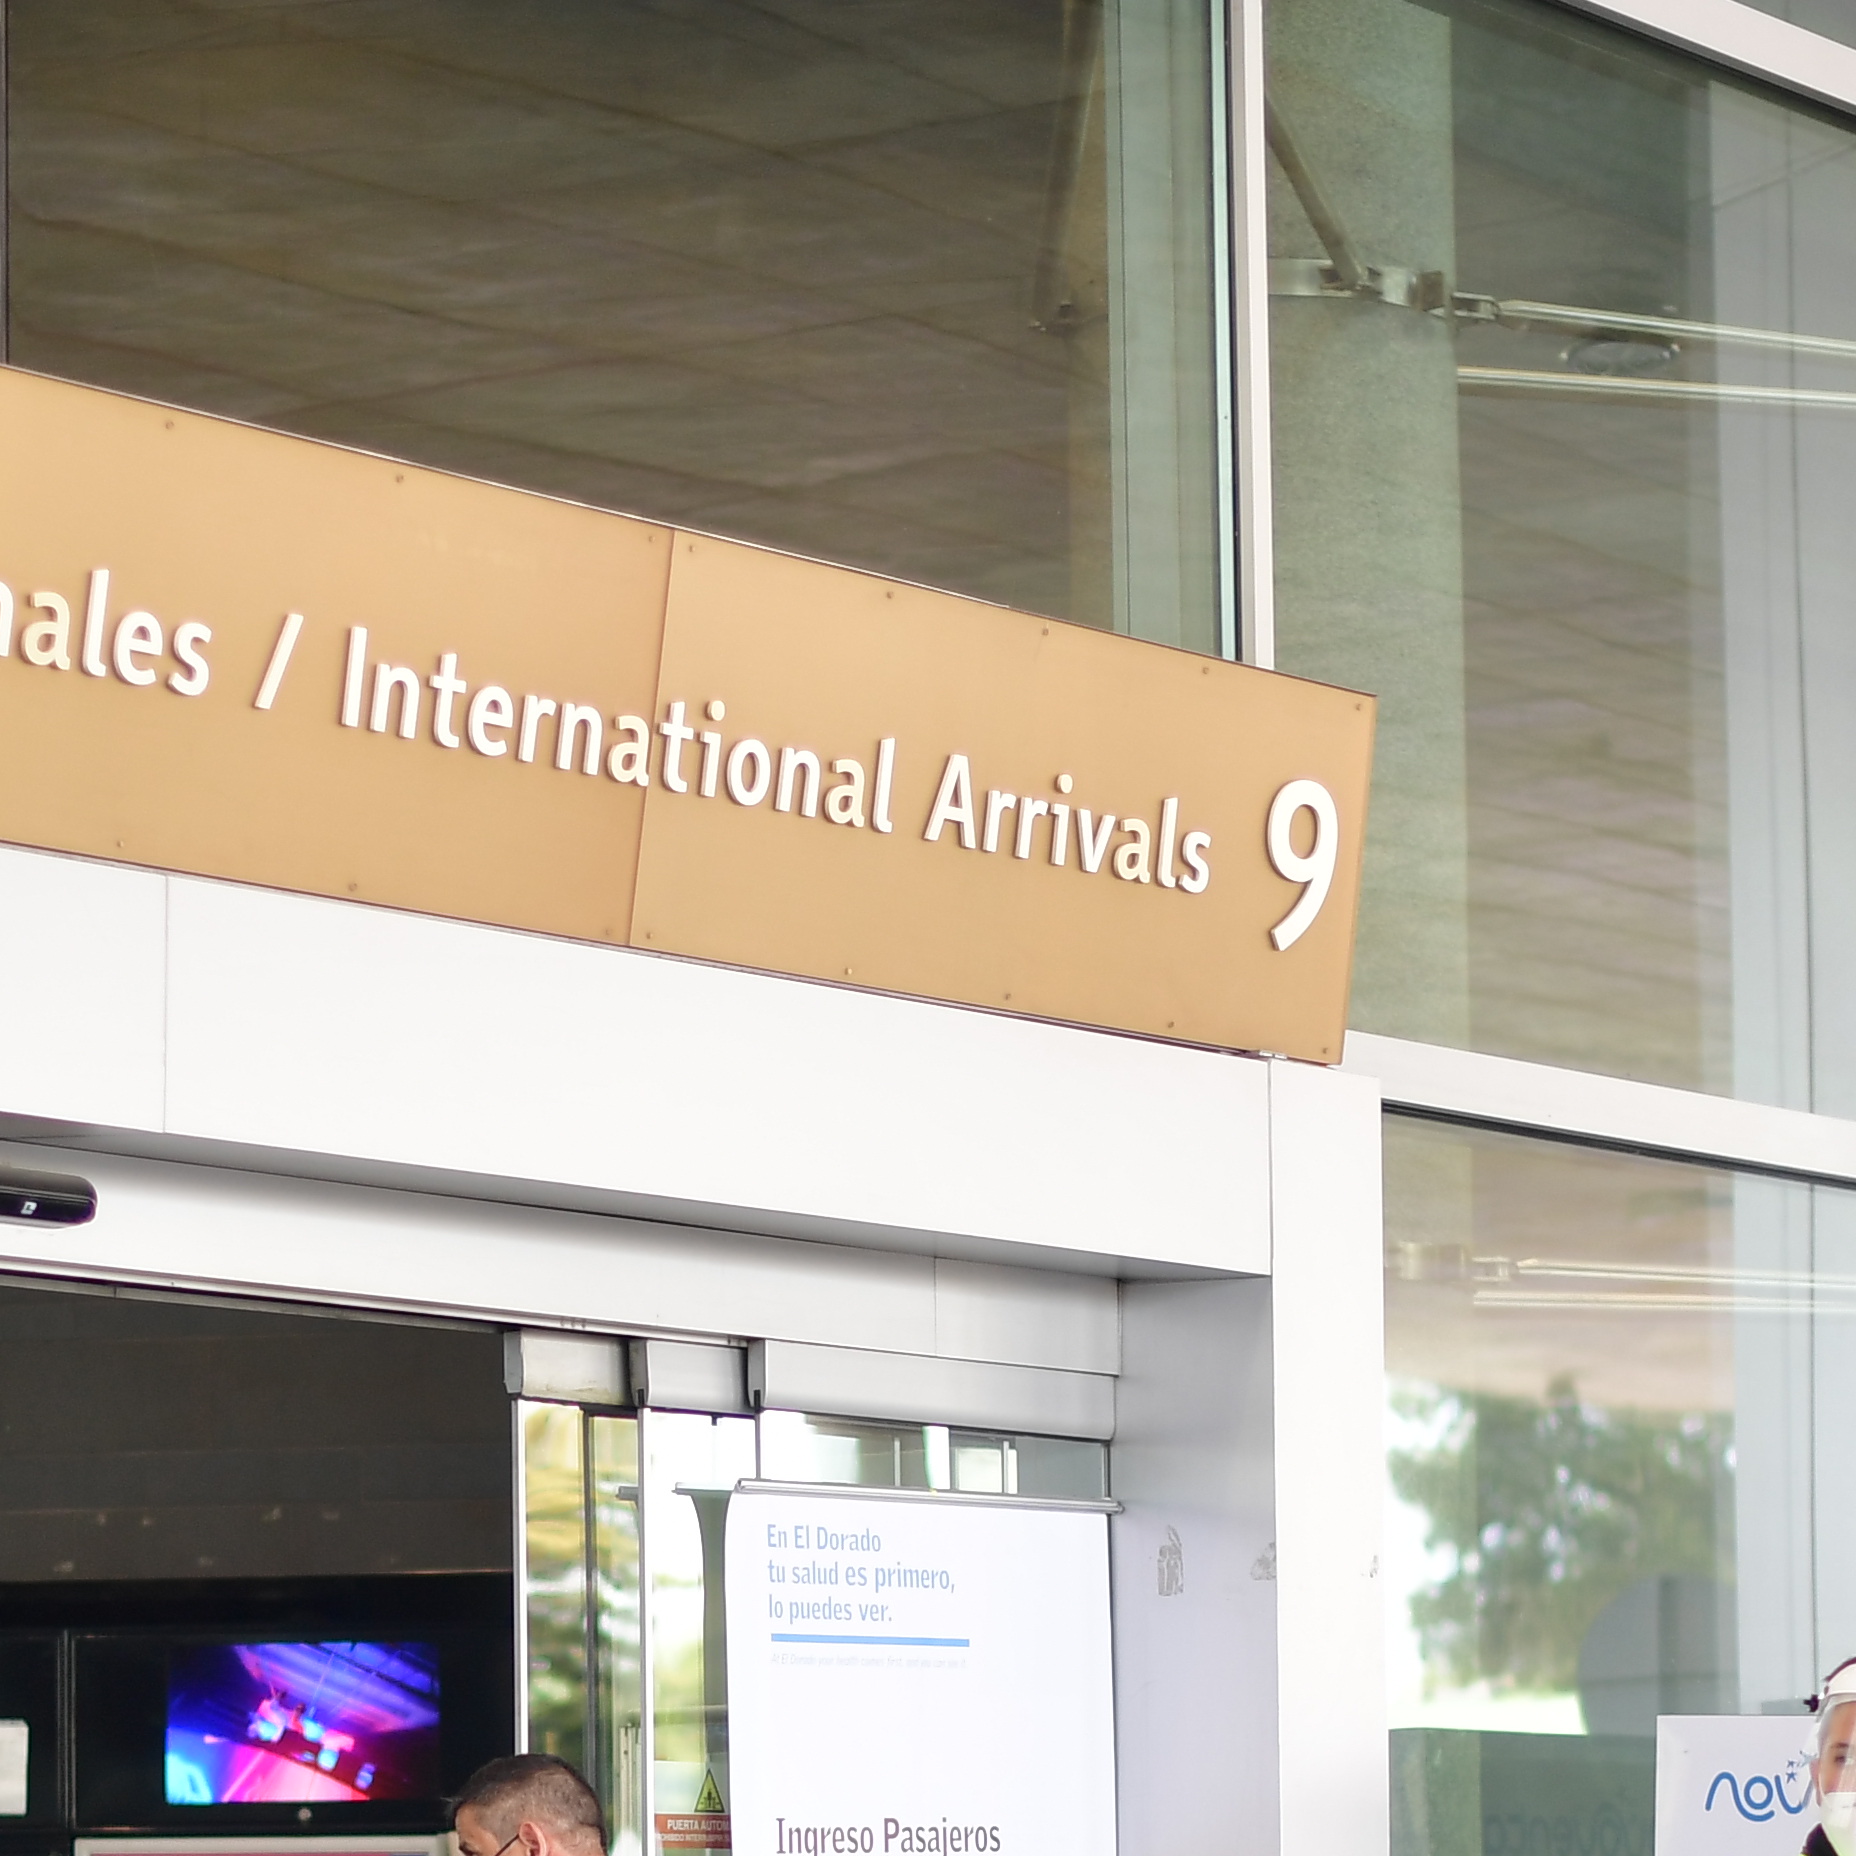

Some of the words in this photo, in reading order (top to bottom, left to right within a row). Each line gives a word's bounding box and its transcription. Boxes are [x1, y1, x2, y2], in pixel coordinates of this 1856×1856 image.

[255, 612, 304, 710] /
[339, 626, 894, 833] International
[924, 754, 1211, 894] Arrivals
[1267, 779, 1339, 951] 9
[767, 1524, 788, 1548] En
[794, 1525, 810, 1549] El
[817, 1527, 882, 1552] Dorado
[768, 1560, 786, 1584] tu
[791, 1561, 839, 1587] salud
[845, 1567, 867, 1588] es
[874, 1562, 955, 1594] primero,
[768, 1594, 784, 1619] lo
[789, 1596, 852, 1624] puedes
[858, 1602, 892, 1623] ver.
[666, 1818, 700, 1831] PUERTA
